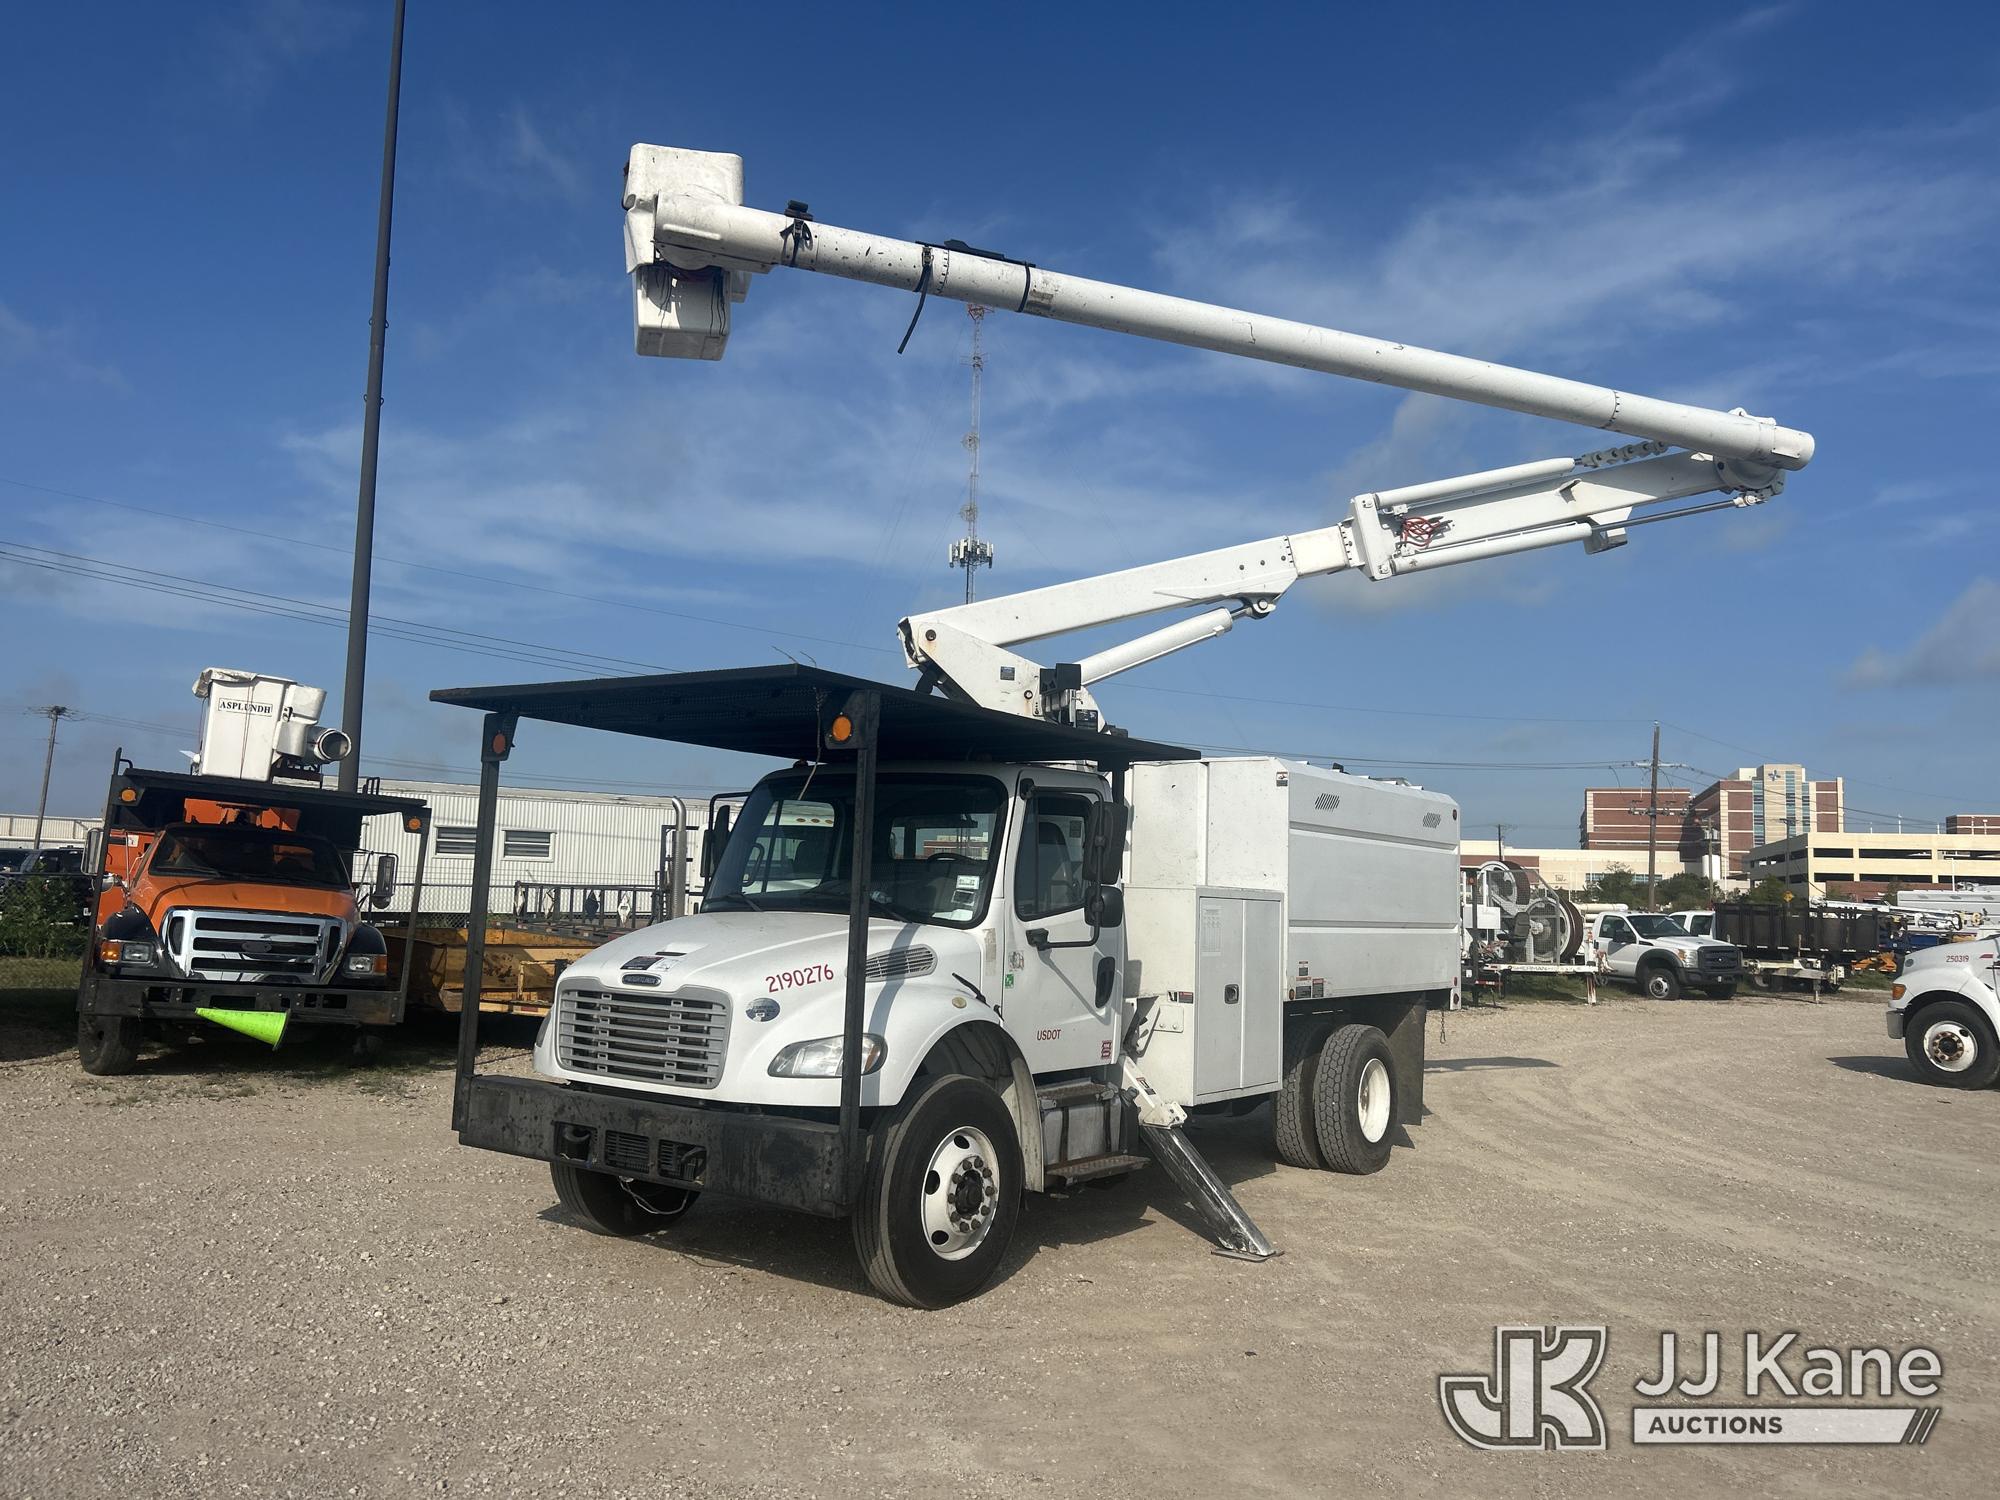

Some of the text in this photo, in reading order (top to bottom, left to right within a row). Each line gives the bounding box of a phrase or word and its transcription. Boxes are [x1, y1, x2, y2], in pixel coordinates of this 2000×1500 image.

[219, 701, 271, 713] ASPLUNDH
[1945, 955, 1970, 963] 250319
[765, 964, 834, 993] 2190276
[1036, 1029, 1062, 1041] USDOT
